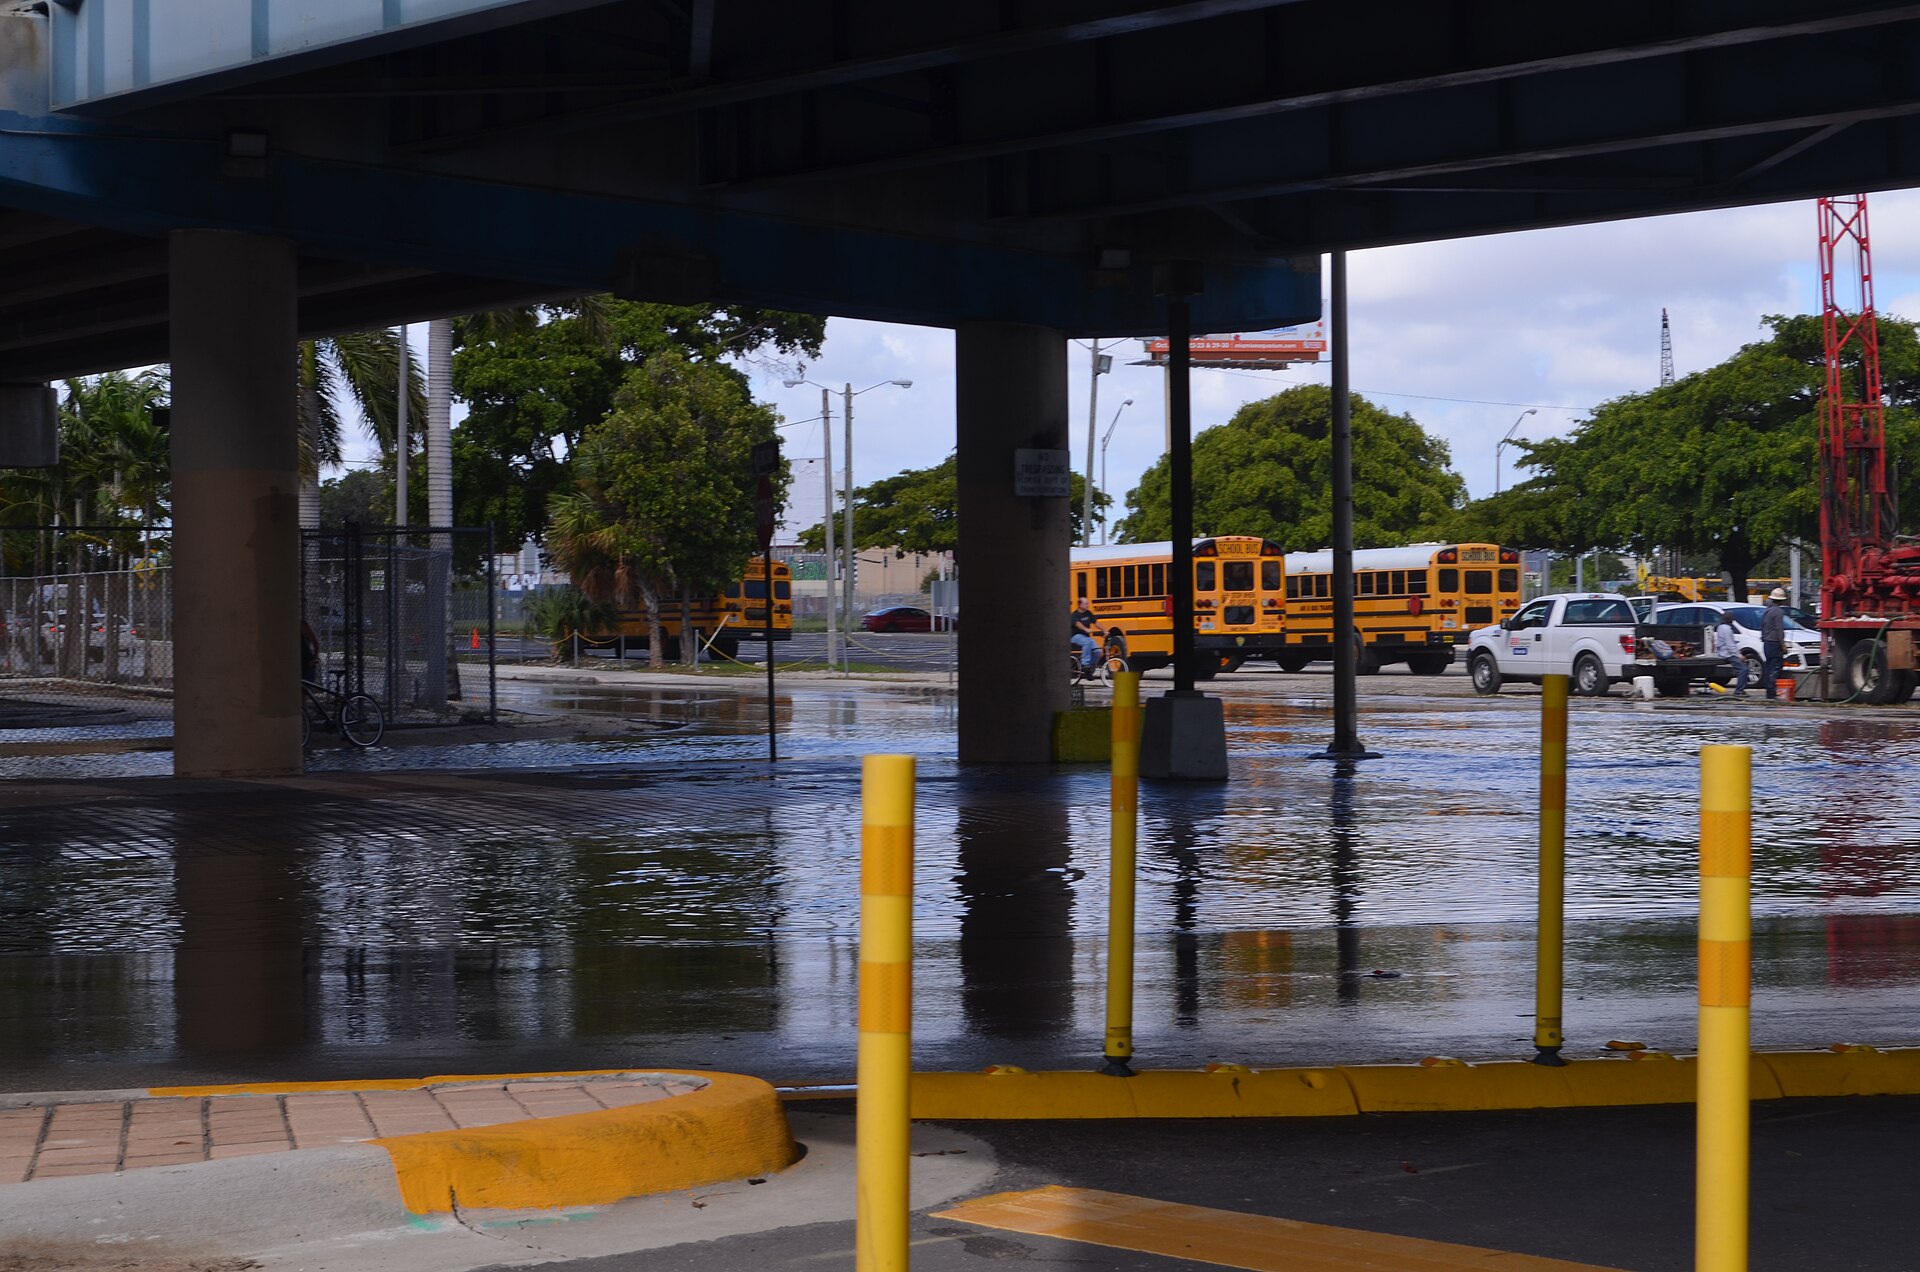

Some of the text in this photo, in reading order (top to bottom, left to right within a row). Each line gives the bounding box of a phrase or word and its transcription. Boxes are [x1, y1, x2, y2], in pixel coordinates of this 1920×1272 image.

[1219, 543, 1259, 554] SCHOOL BUS
[1461, 551, 1496, 561] SCHOOL BUS
